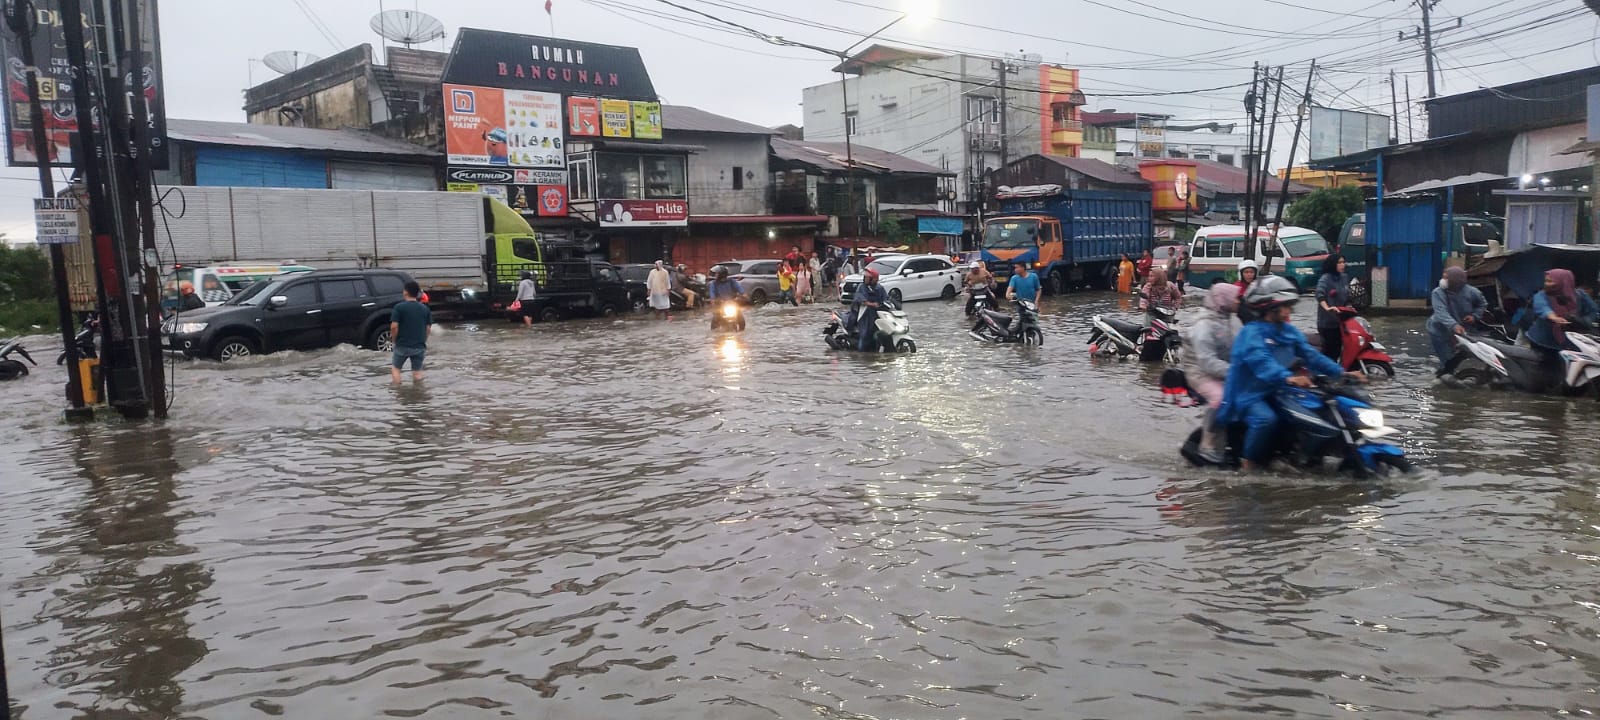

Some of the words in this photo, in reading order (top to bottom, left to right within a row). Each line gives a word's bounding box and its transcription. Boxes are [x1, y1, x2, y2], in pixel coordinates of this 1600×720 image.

[531, 45, 583, 65] RUMAH
[498, 62, 618, 86] BANGUNAN
[448, 115, 481, 123] NIPPON
[459, 172, 505, 180] PLATINUM
[34, 199, 77, 210] MENJUAL
